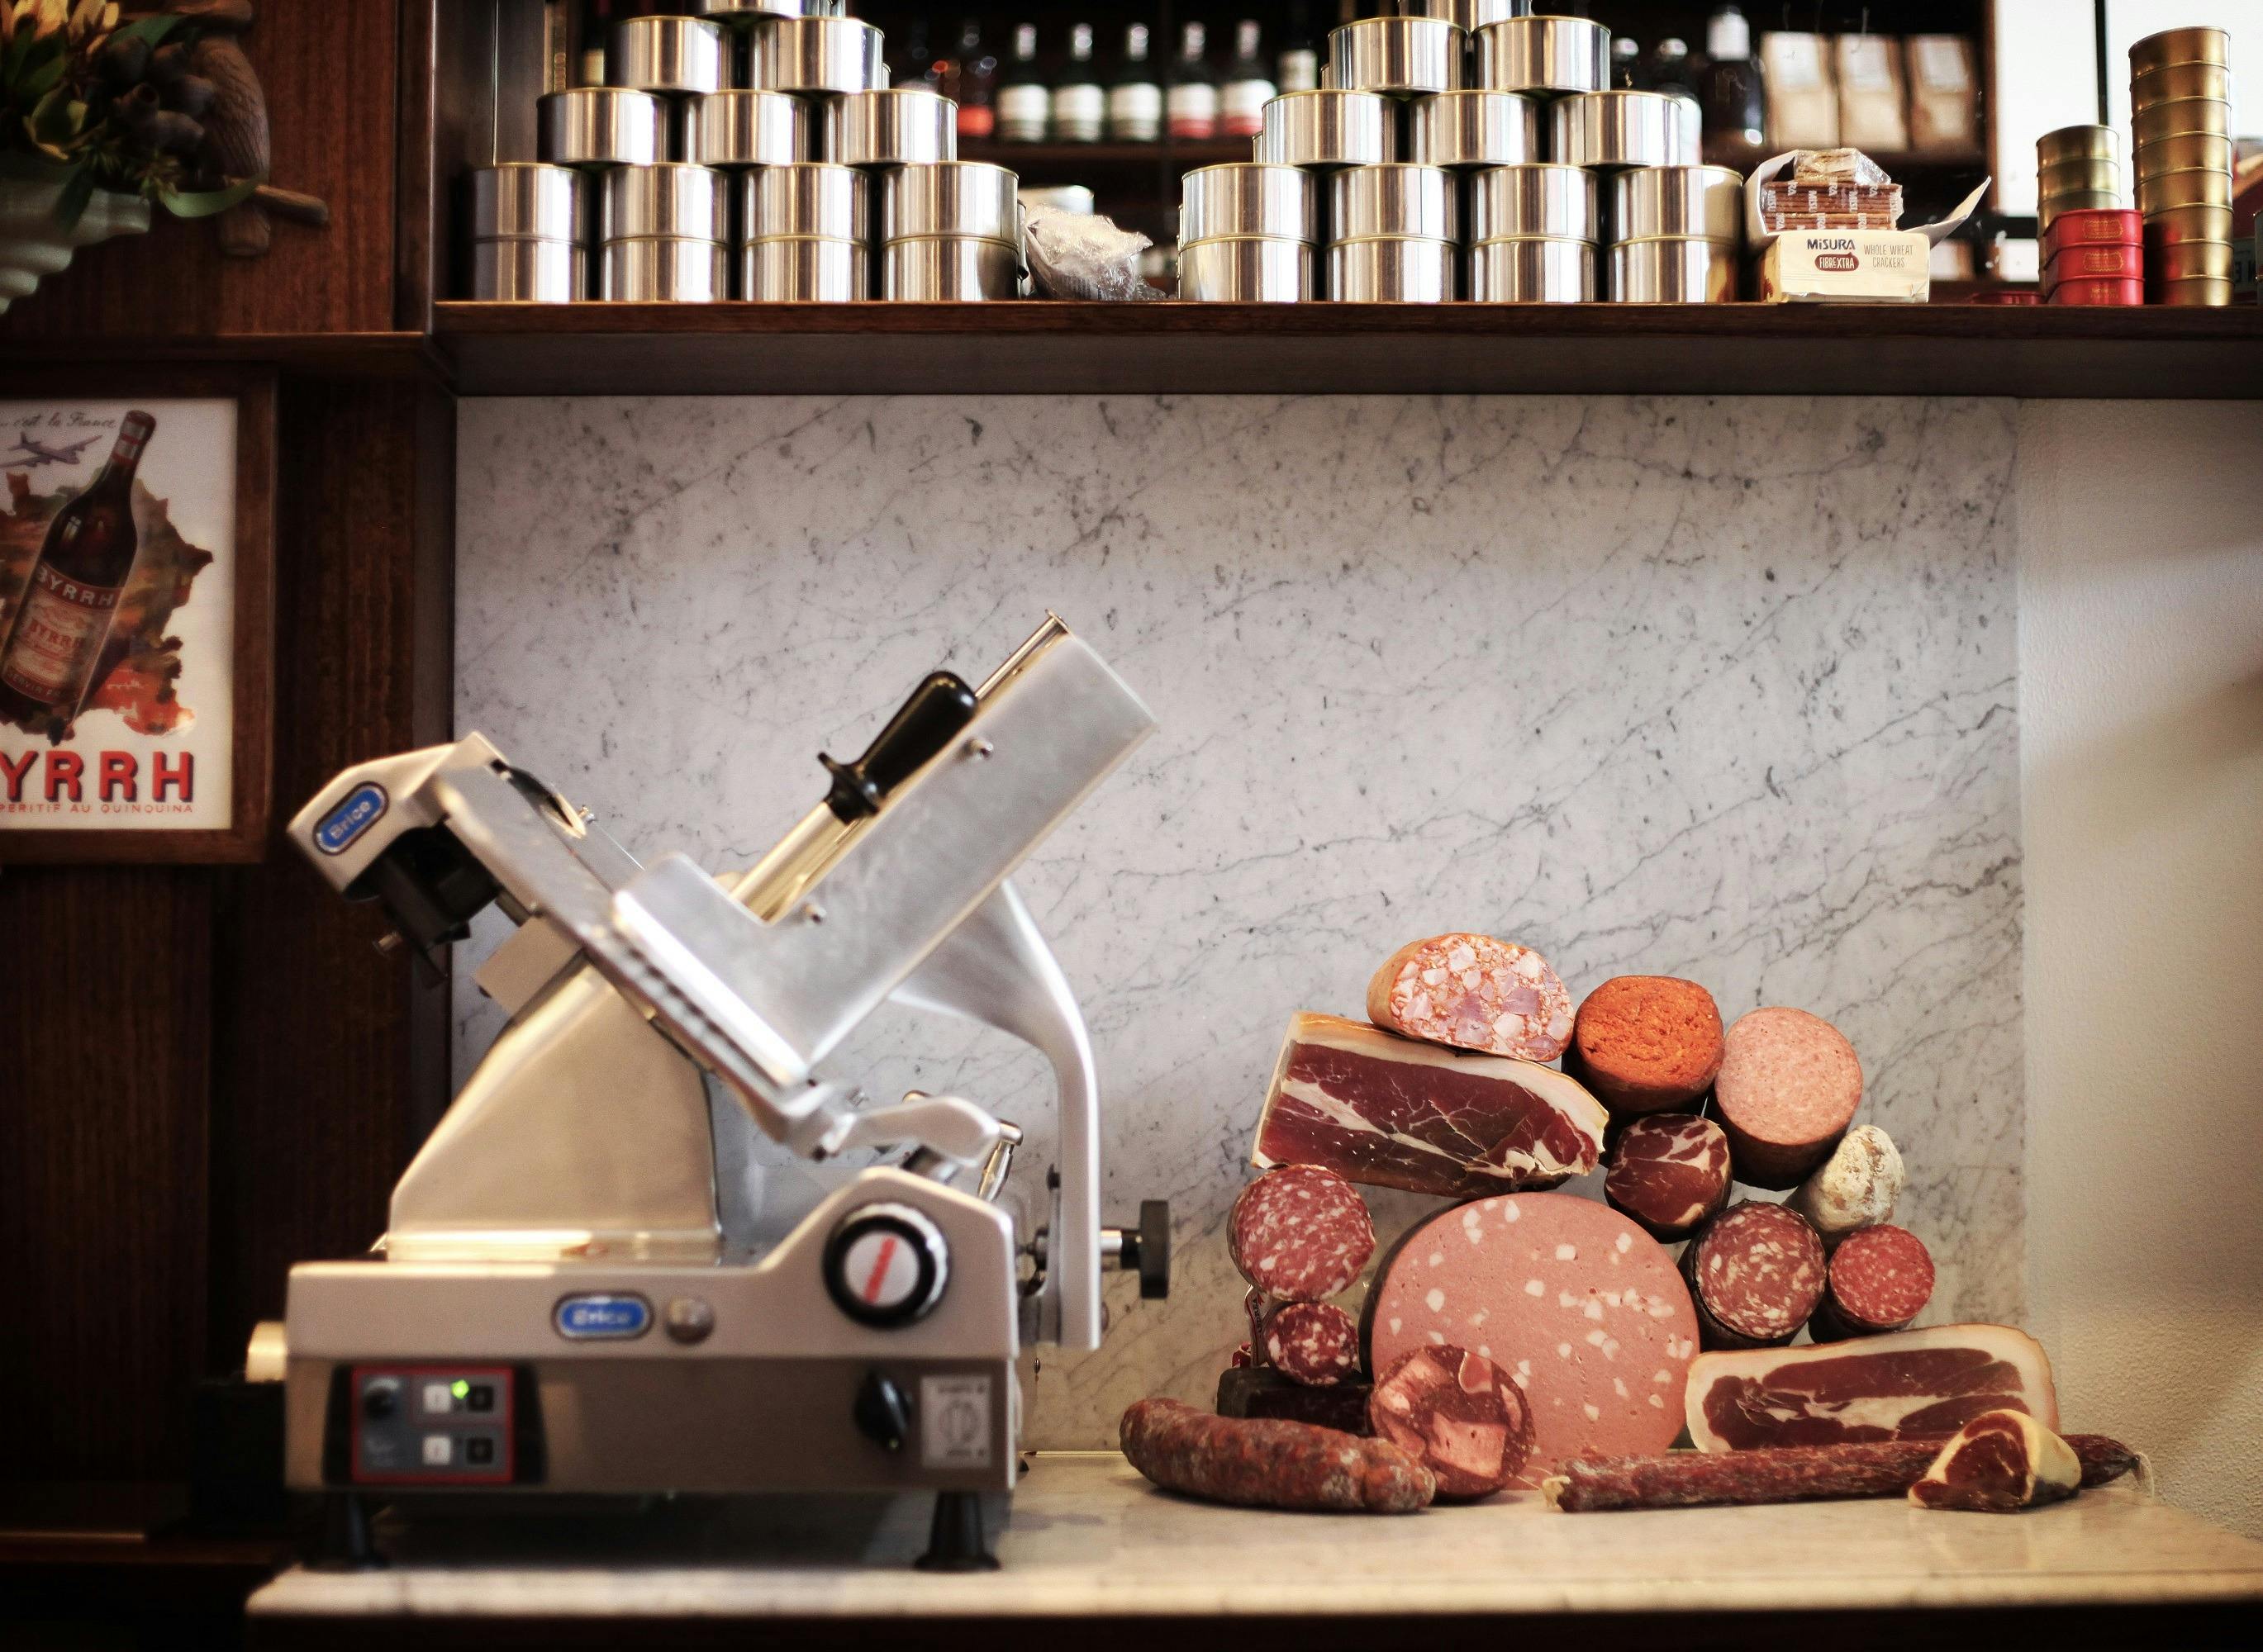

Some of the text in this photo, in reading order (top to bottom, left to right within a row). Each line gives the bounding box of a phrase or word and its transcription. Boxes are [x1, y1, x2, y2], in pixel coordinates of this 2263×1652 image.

[1864, 244, 1914, 255] WHOLE WHEAT
[1872, 257, 1905, 268] CRACKERS
[70, 804, 93, 814] AU
[101, 804, 193, 814] QUINQUINA
